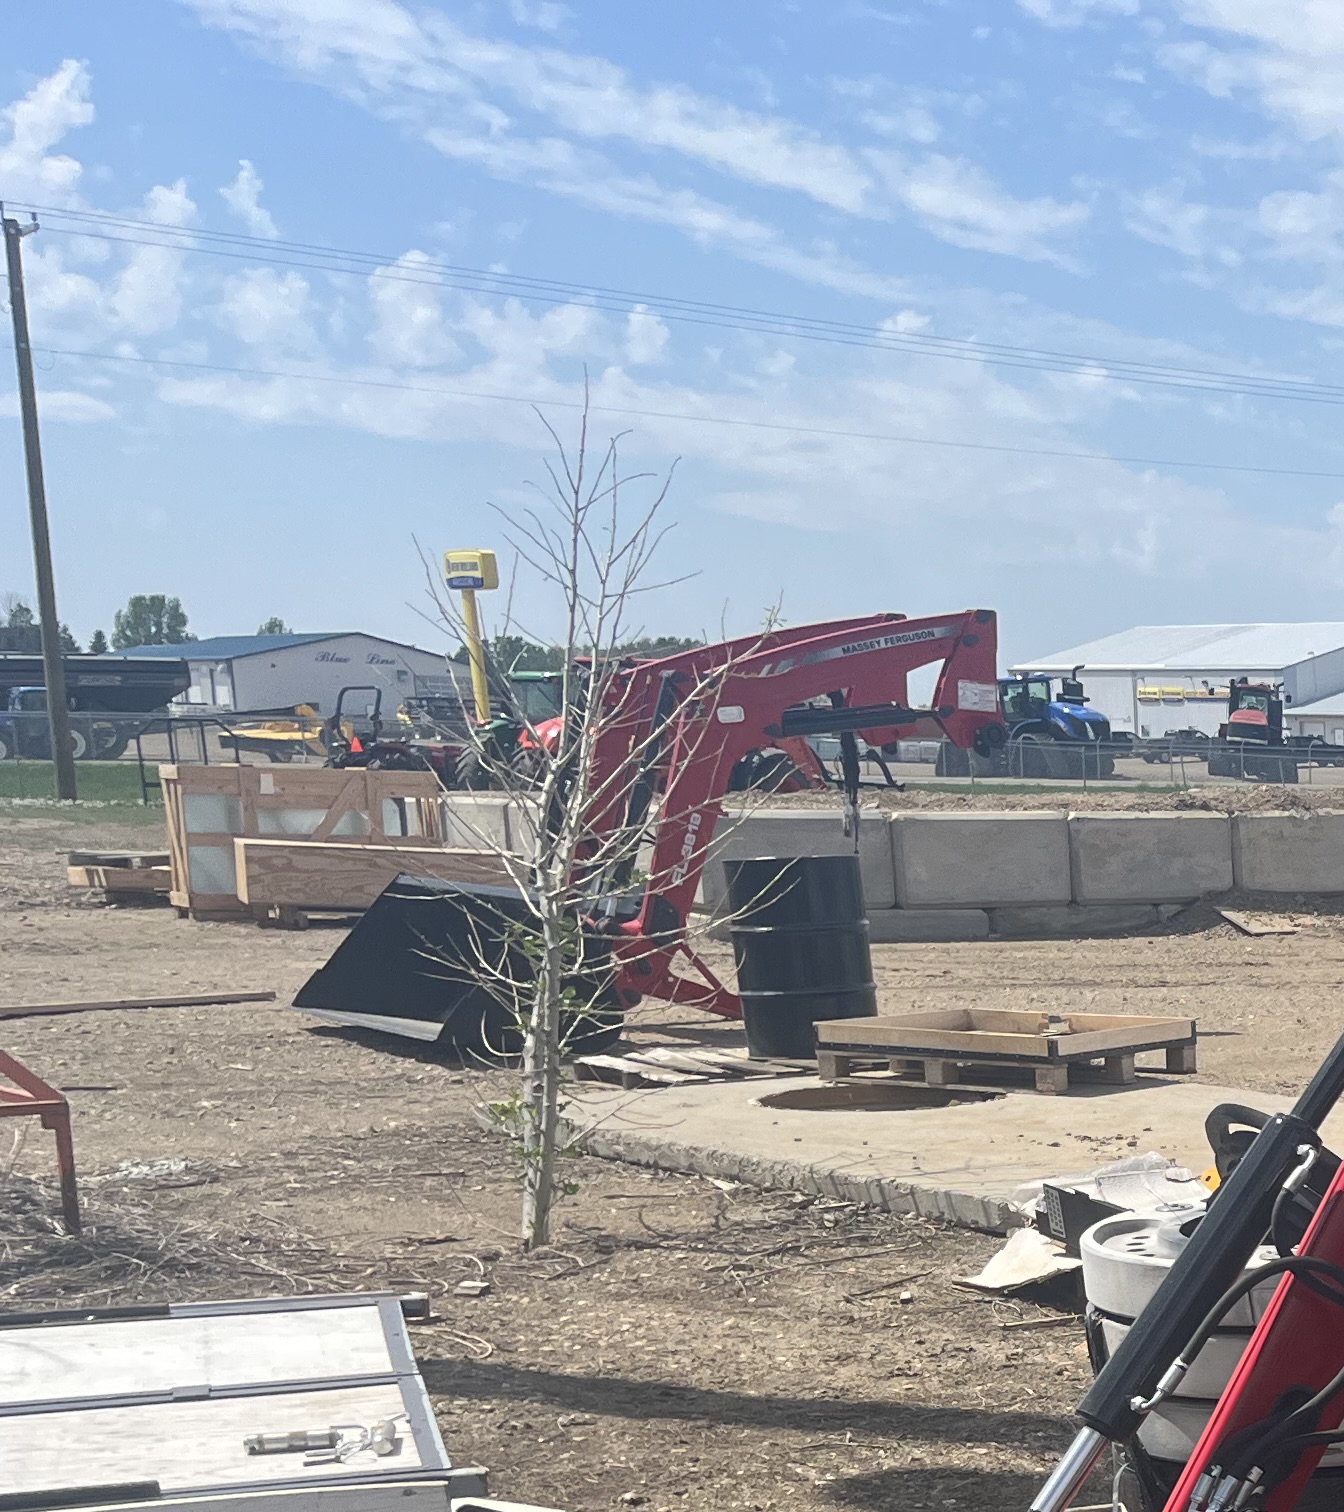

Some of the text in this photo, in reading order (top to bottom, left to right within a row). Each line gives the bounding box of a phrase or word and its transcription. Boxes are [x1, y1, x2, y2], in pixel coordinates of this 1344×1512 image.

[841, 630, 936, 655] MASSEY FERGUSON
[315, 651, 351, 664] Blue
